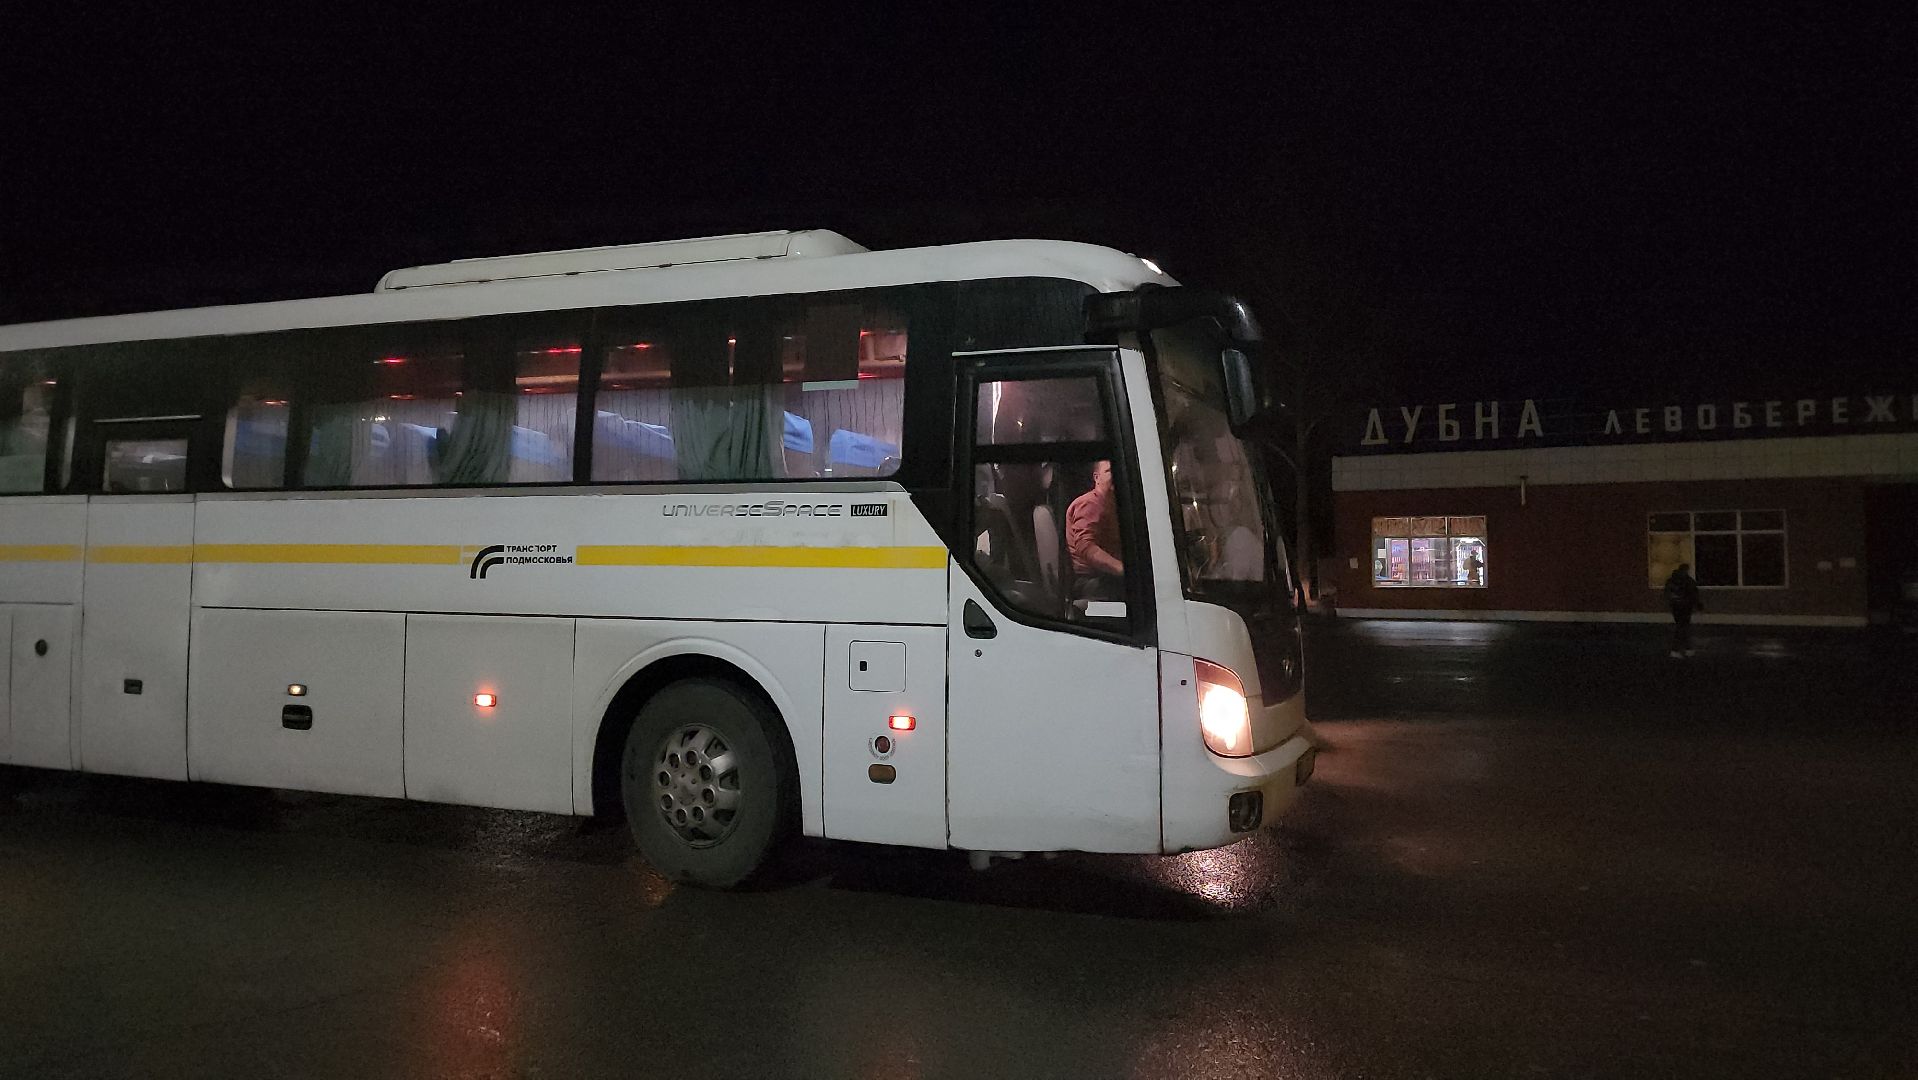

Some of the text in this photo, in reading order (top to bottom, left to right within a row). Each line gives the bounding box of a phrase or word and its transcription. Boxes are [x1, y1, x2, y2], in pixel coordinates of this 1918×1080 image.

[1360, 399, 1545, 446] ДУБНА
[851, 504, 887, 516] LUXURY
[506, 556, 573, 565] ПОДМОСКОВЬЯ
